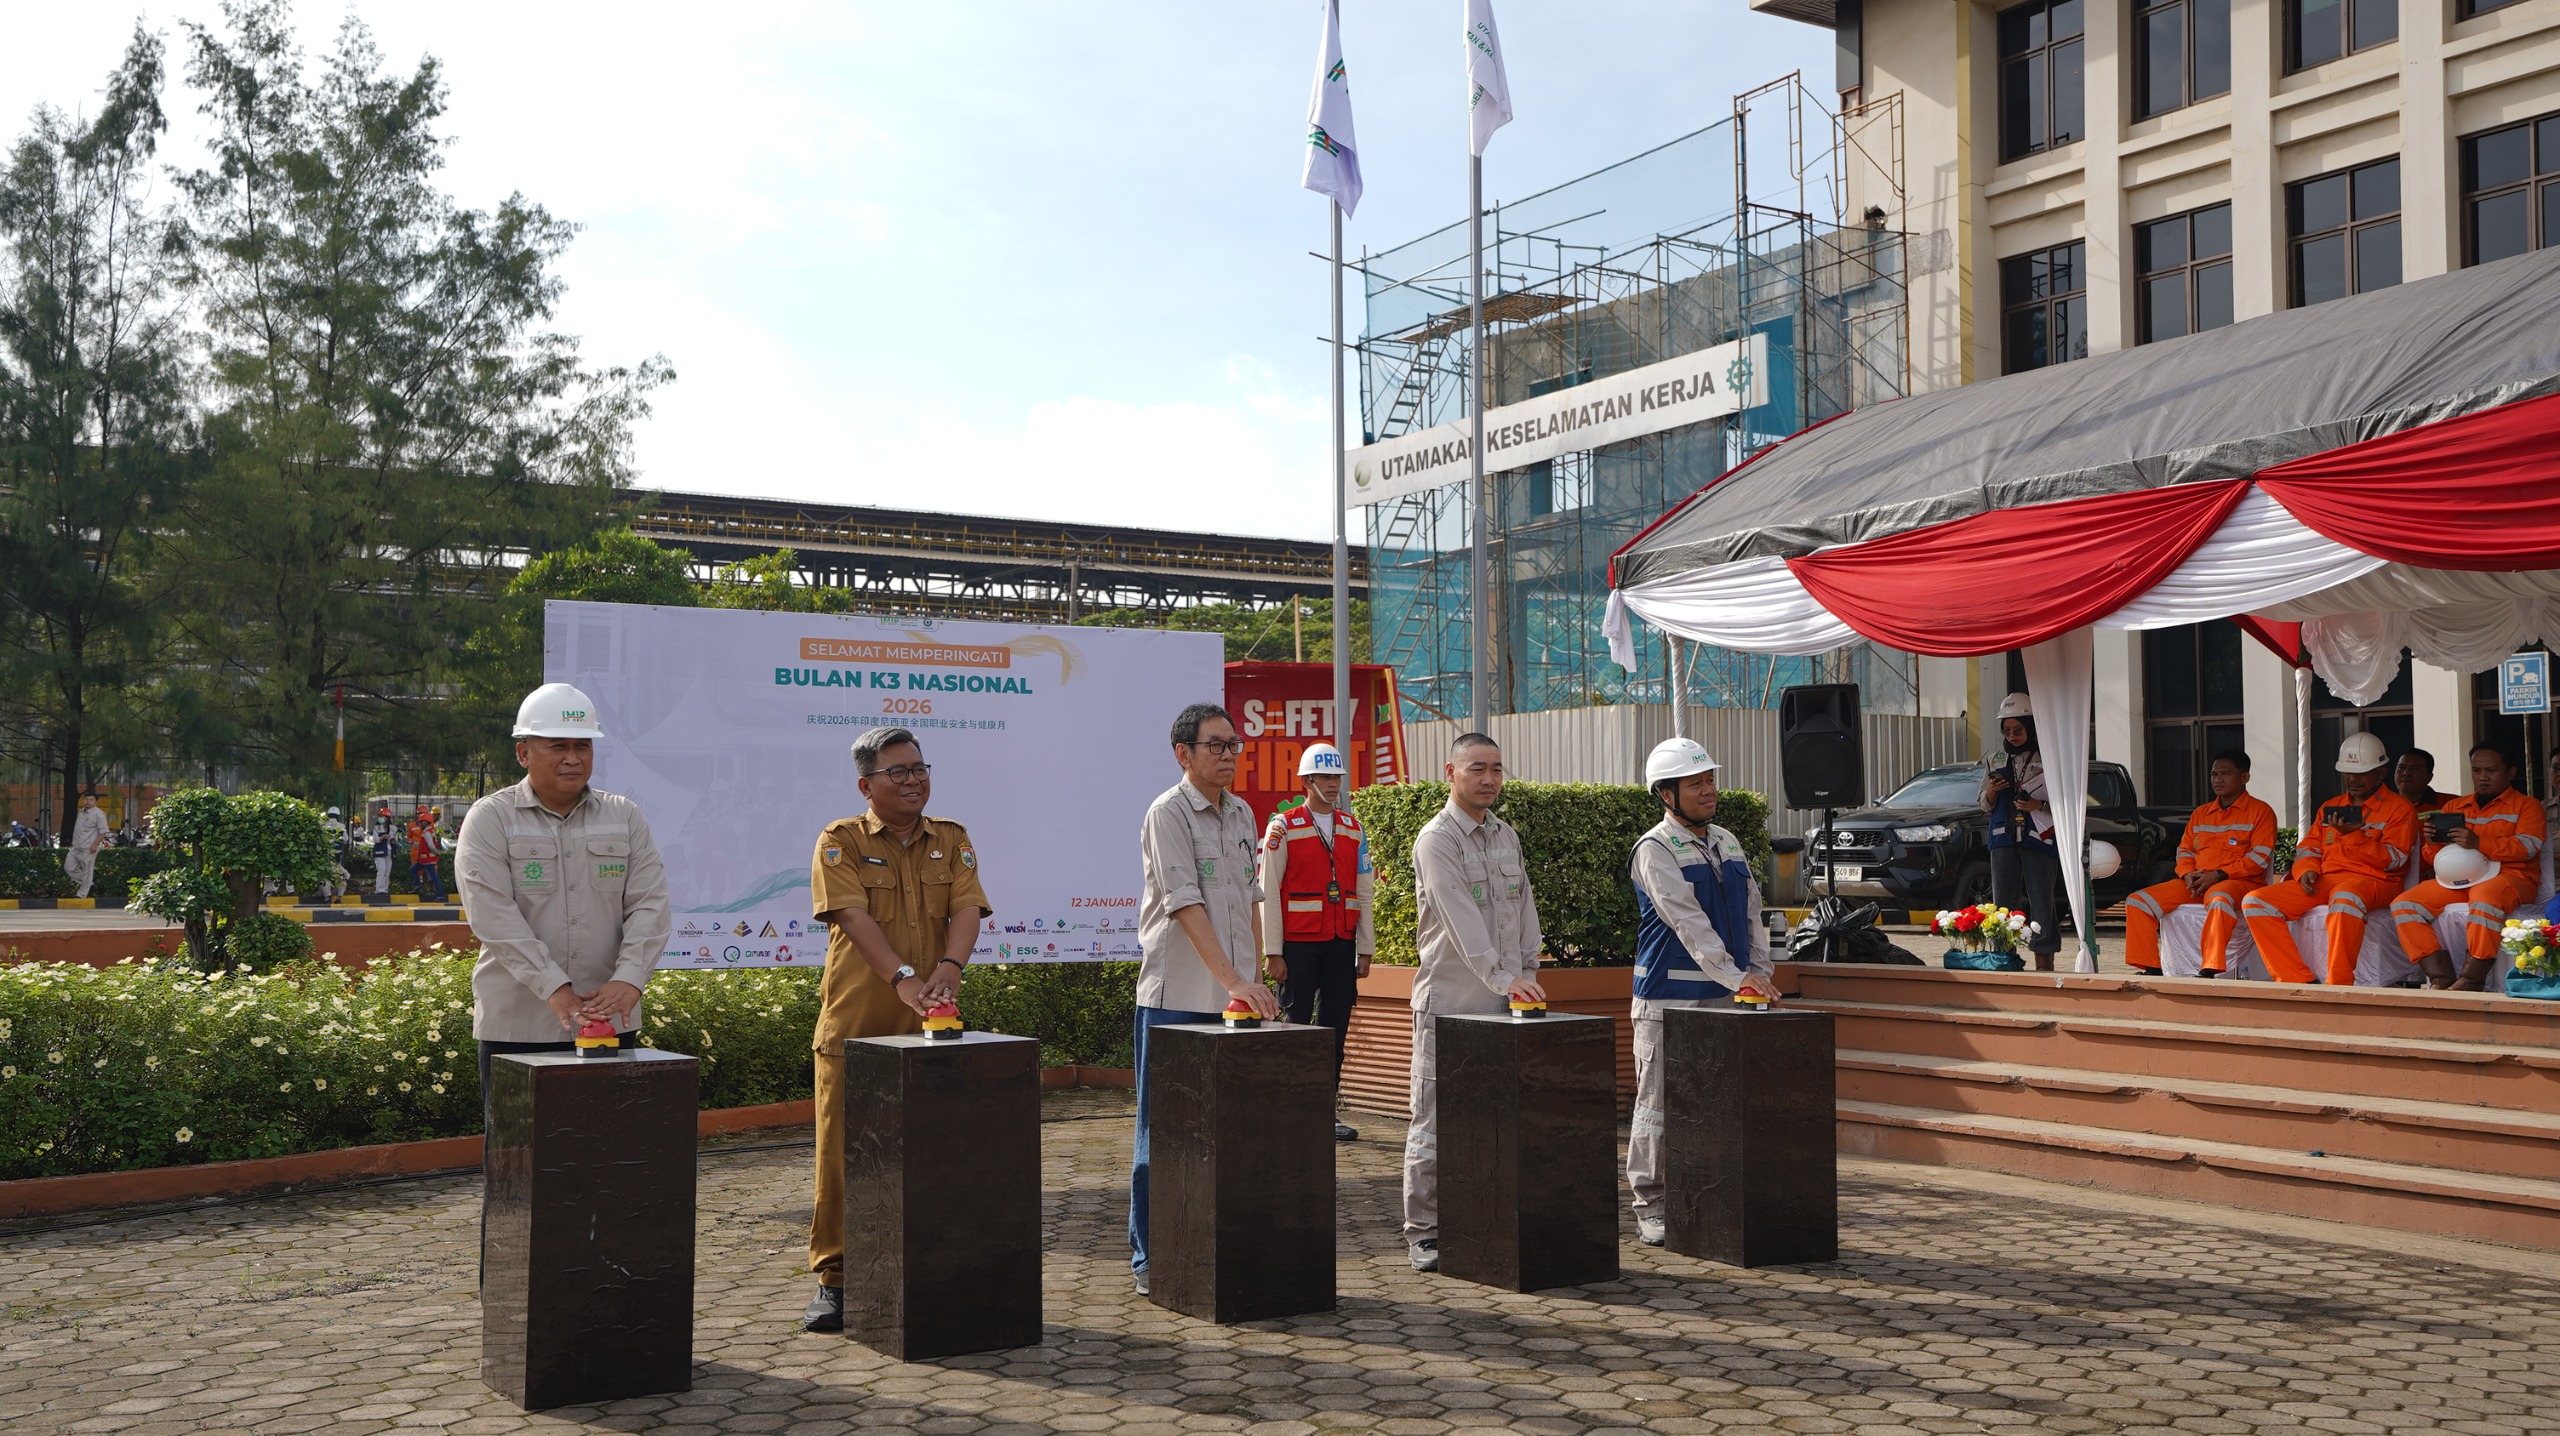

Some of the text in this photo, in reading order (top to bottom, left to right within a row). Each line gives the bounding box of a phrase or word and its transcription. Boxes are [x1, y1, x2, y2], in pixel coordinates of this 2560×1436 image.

[1477, 22, 1492, 39] UTA
[1487, 393, 1632, 453] KESELAMATAN
[1640, 371, 1716, 413] KERJA
[808, 643, 1003, 663] SELAMAT MEMPERINGATI
[775, 667, 1033, 694] BULAN K3 NASIONAL
[2509, 663, 2526, 684] P
[882, 697, 932, 715] 2026
[561, 710, 585, 722] IMIP
[1233, 740, 1367, 793] FIRT
[1314, 753, 1344, 769] PRO
[1071, 897, 1137, 908] 12 JANUARI
[1017, 946, 1039, 955] ESG
